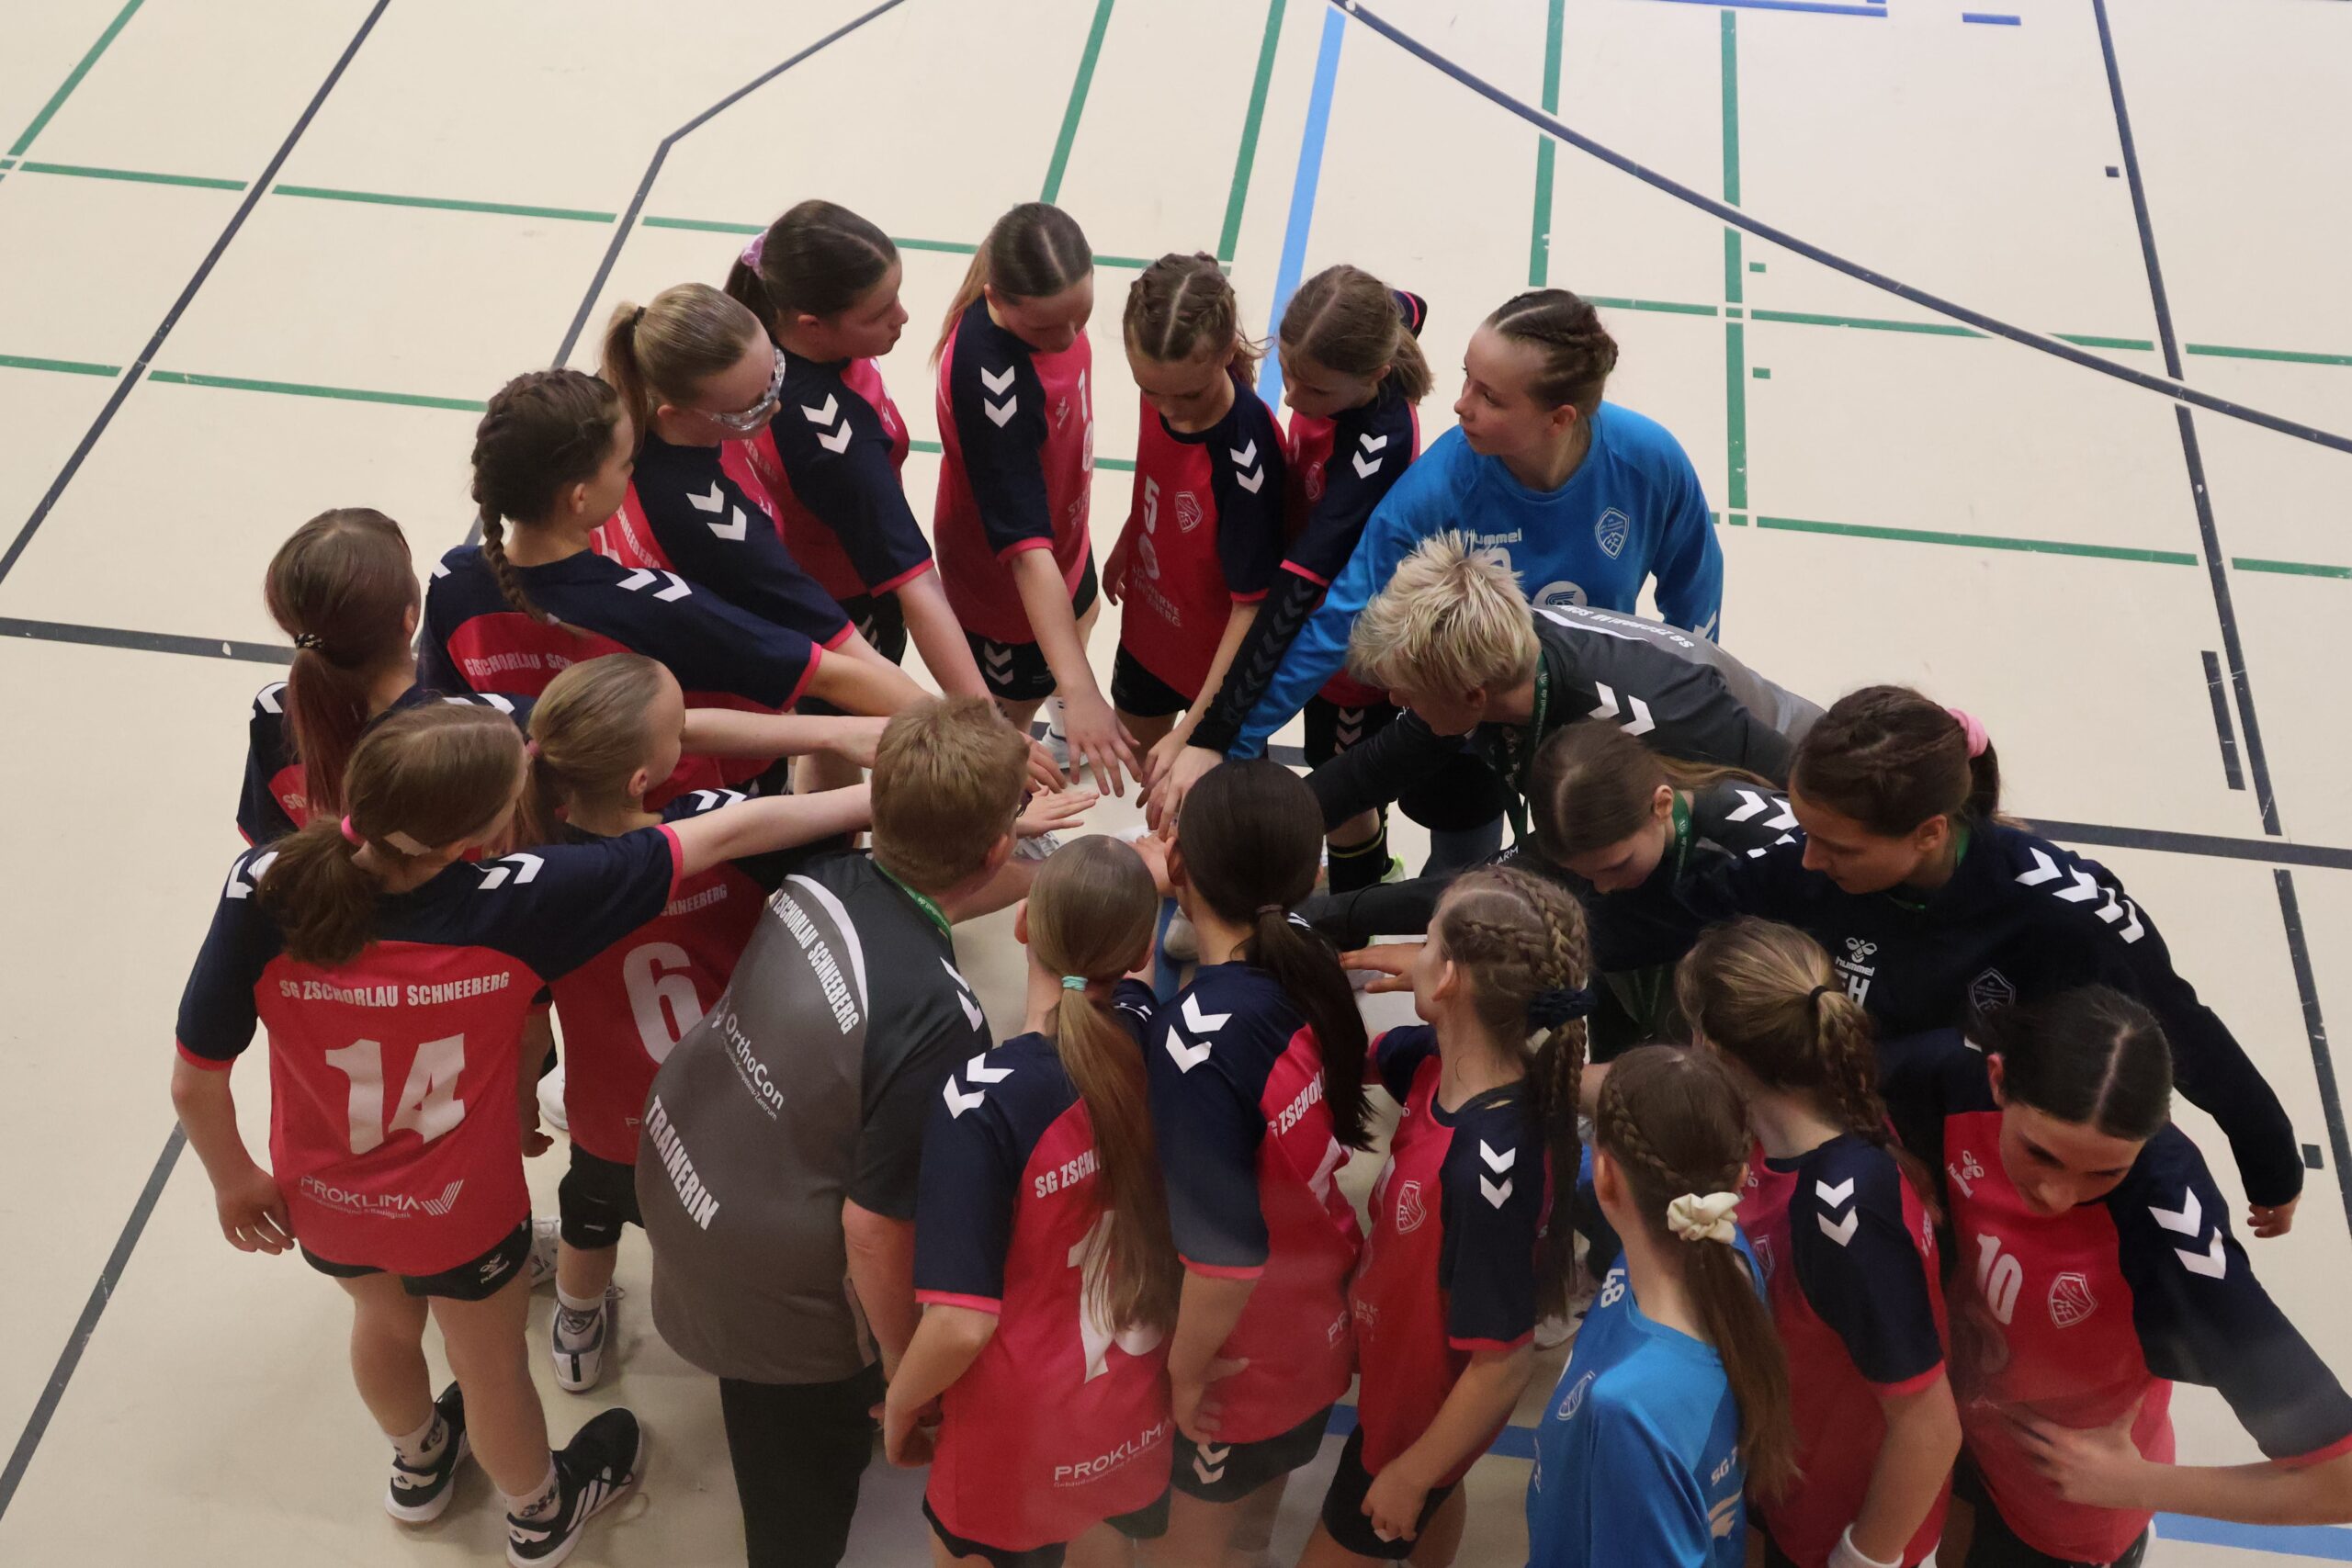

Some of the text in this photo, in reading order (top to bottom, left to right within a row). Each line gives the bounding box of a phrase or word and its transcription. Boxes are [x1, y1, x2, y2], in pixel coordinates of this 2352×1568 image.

[1144, 475, 1160, 535] 5
[278, 971, 511, 1008] SG ZSCHORLAU SCHNEEBERG
[623, 942, 704, 1066] 6
[807, 940, 860, 1036] SCHNEEBERG
[1835, 955, 1875, 977] hummel
[324, 1032, 467, 1156] 14
[725, 1013, 785, 1111] OrthoCon
[300, 1175, 421, 1212] PROKLIMA
[645, 1094, 720, 1232] TRAINERIN
[1035, 1170, 1058, 1199] SG
[1976, 1233, 2023, 1325] 10
